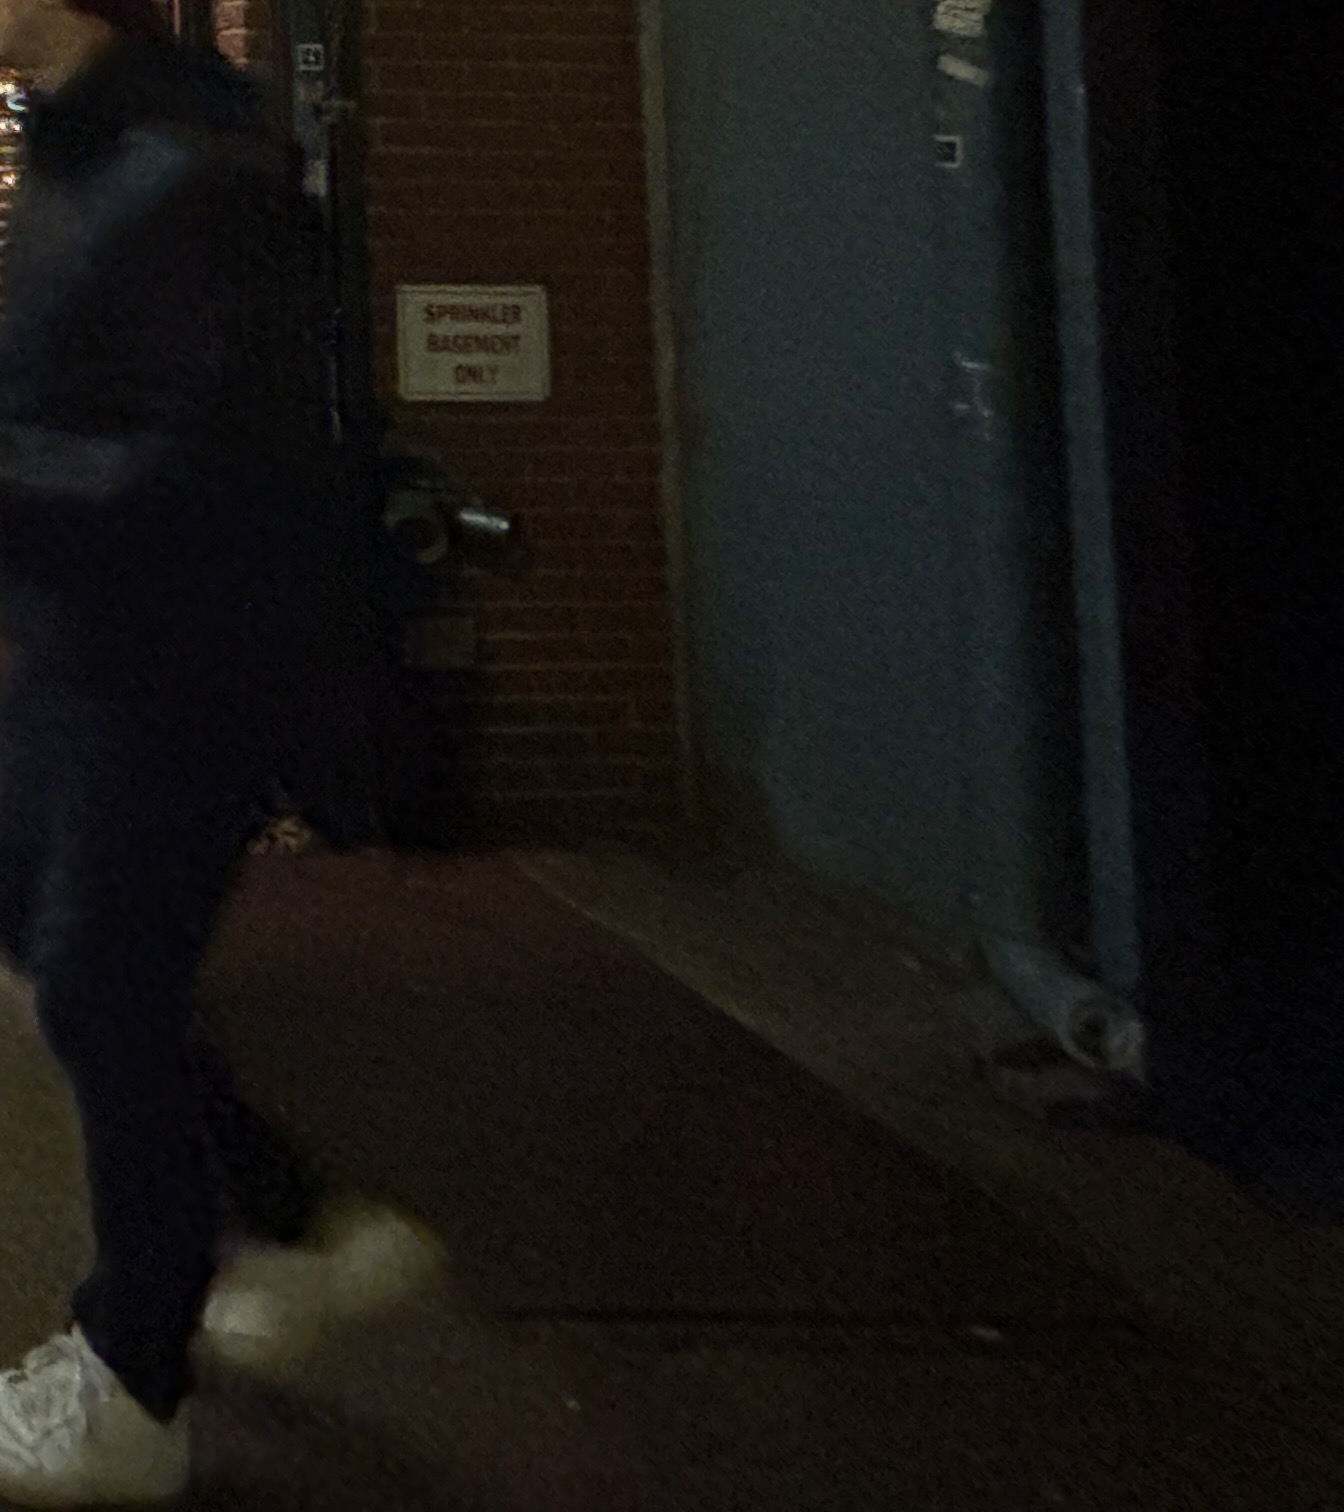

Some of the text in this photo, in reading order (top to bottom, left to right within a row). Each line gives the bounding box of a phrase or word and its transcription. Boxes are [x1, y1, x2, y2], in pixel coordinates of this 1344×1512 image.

[422, 302, 523, 326] SPRINKLER
[425, 333, 521, 355] BASEMENT
[453, 363, 499, 385] ONLY
